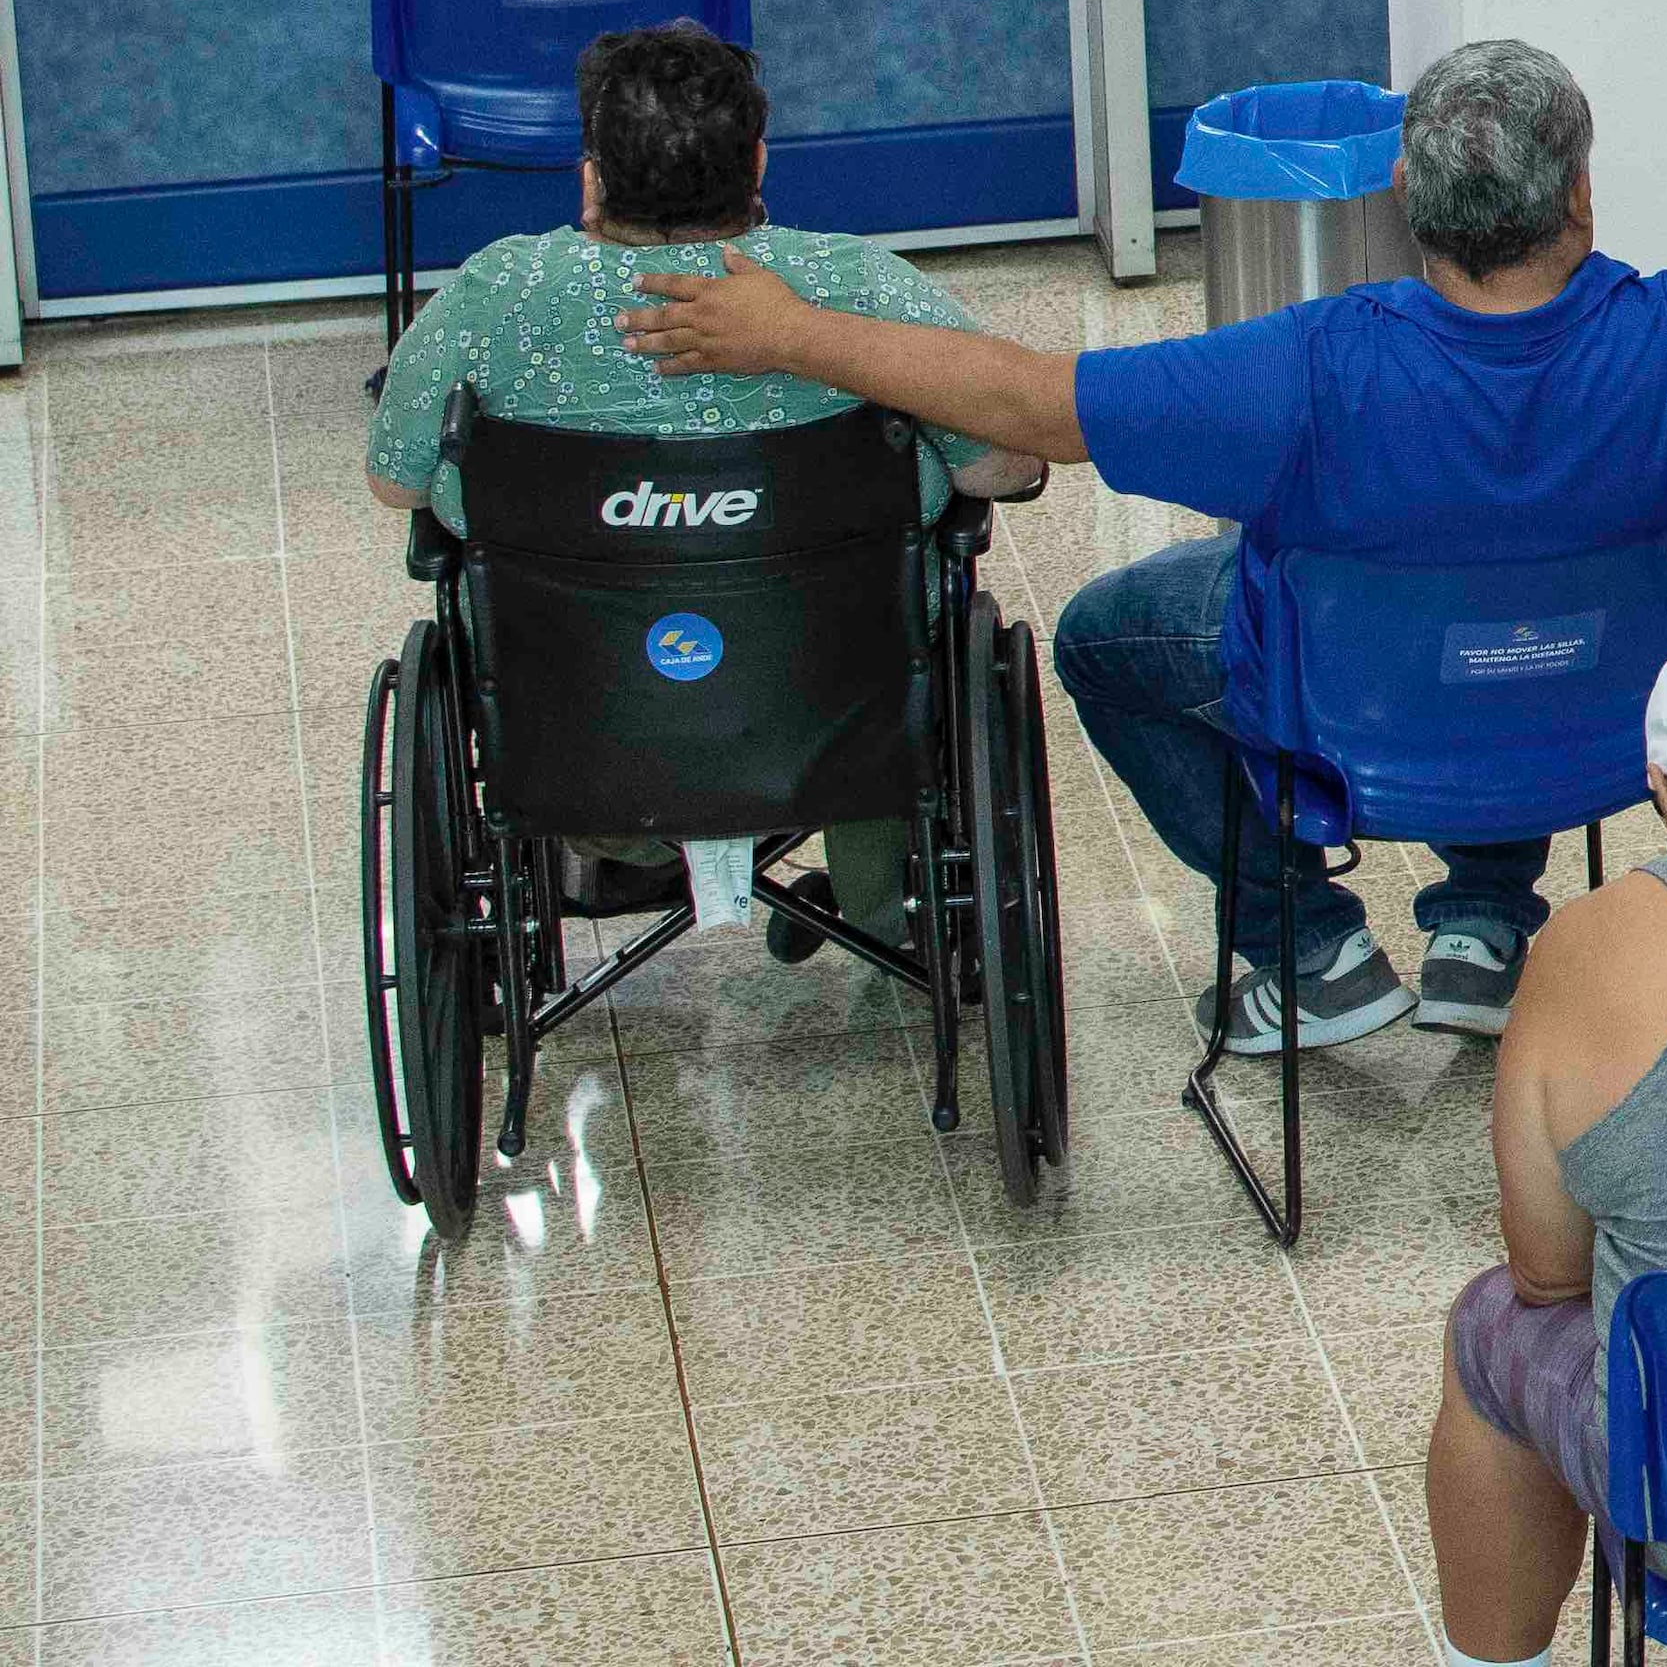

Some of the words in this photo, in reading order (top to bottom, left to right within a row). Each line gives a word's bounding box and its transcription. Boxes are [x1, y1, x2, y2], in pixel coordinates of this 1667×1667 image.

[601, 481, 758, 526] drive
[1459, 649, 1488, 657] FAVOR
[1506, 645, 1538, 654] MOVER
[1540, 642, 1555, 650] LAS
[660, 656, 680, 665] CAJA
[692, 654, 712, 663] ANDE
[1468, 656, 1518, 664] MANTENGA
